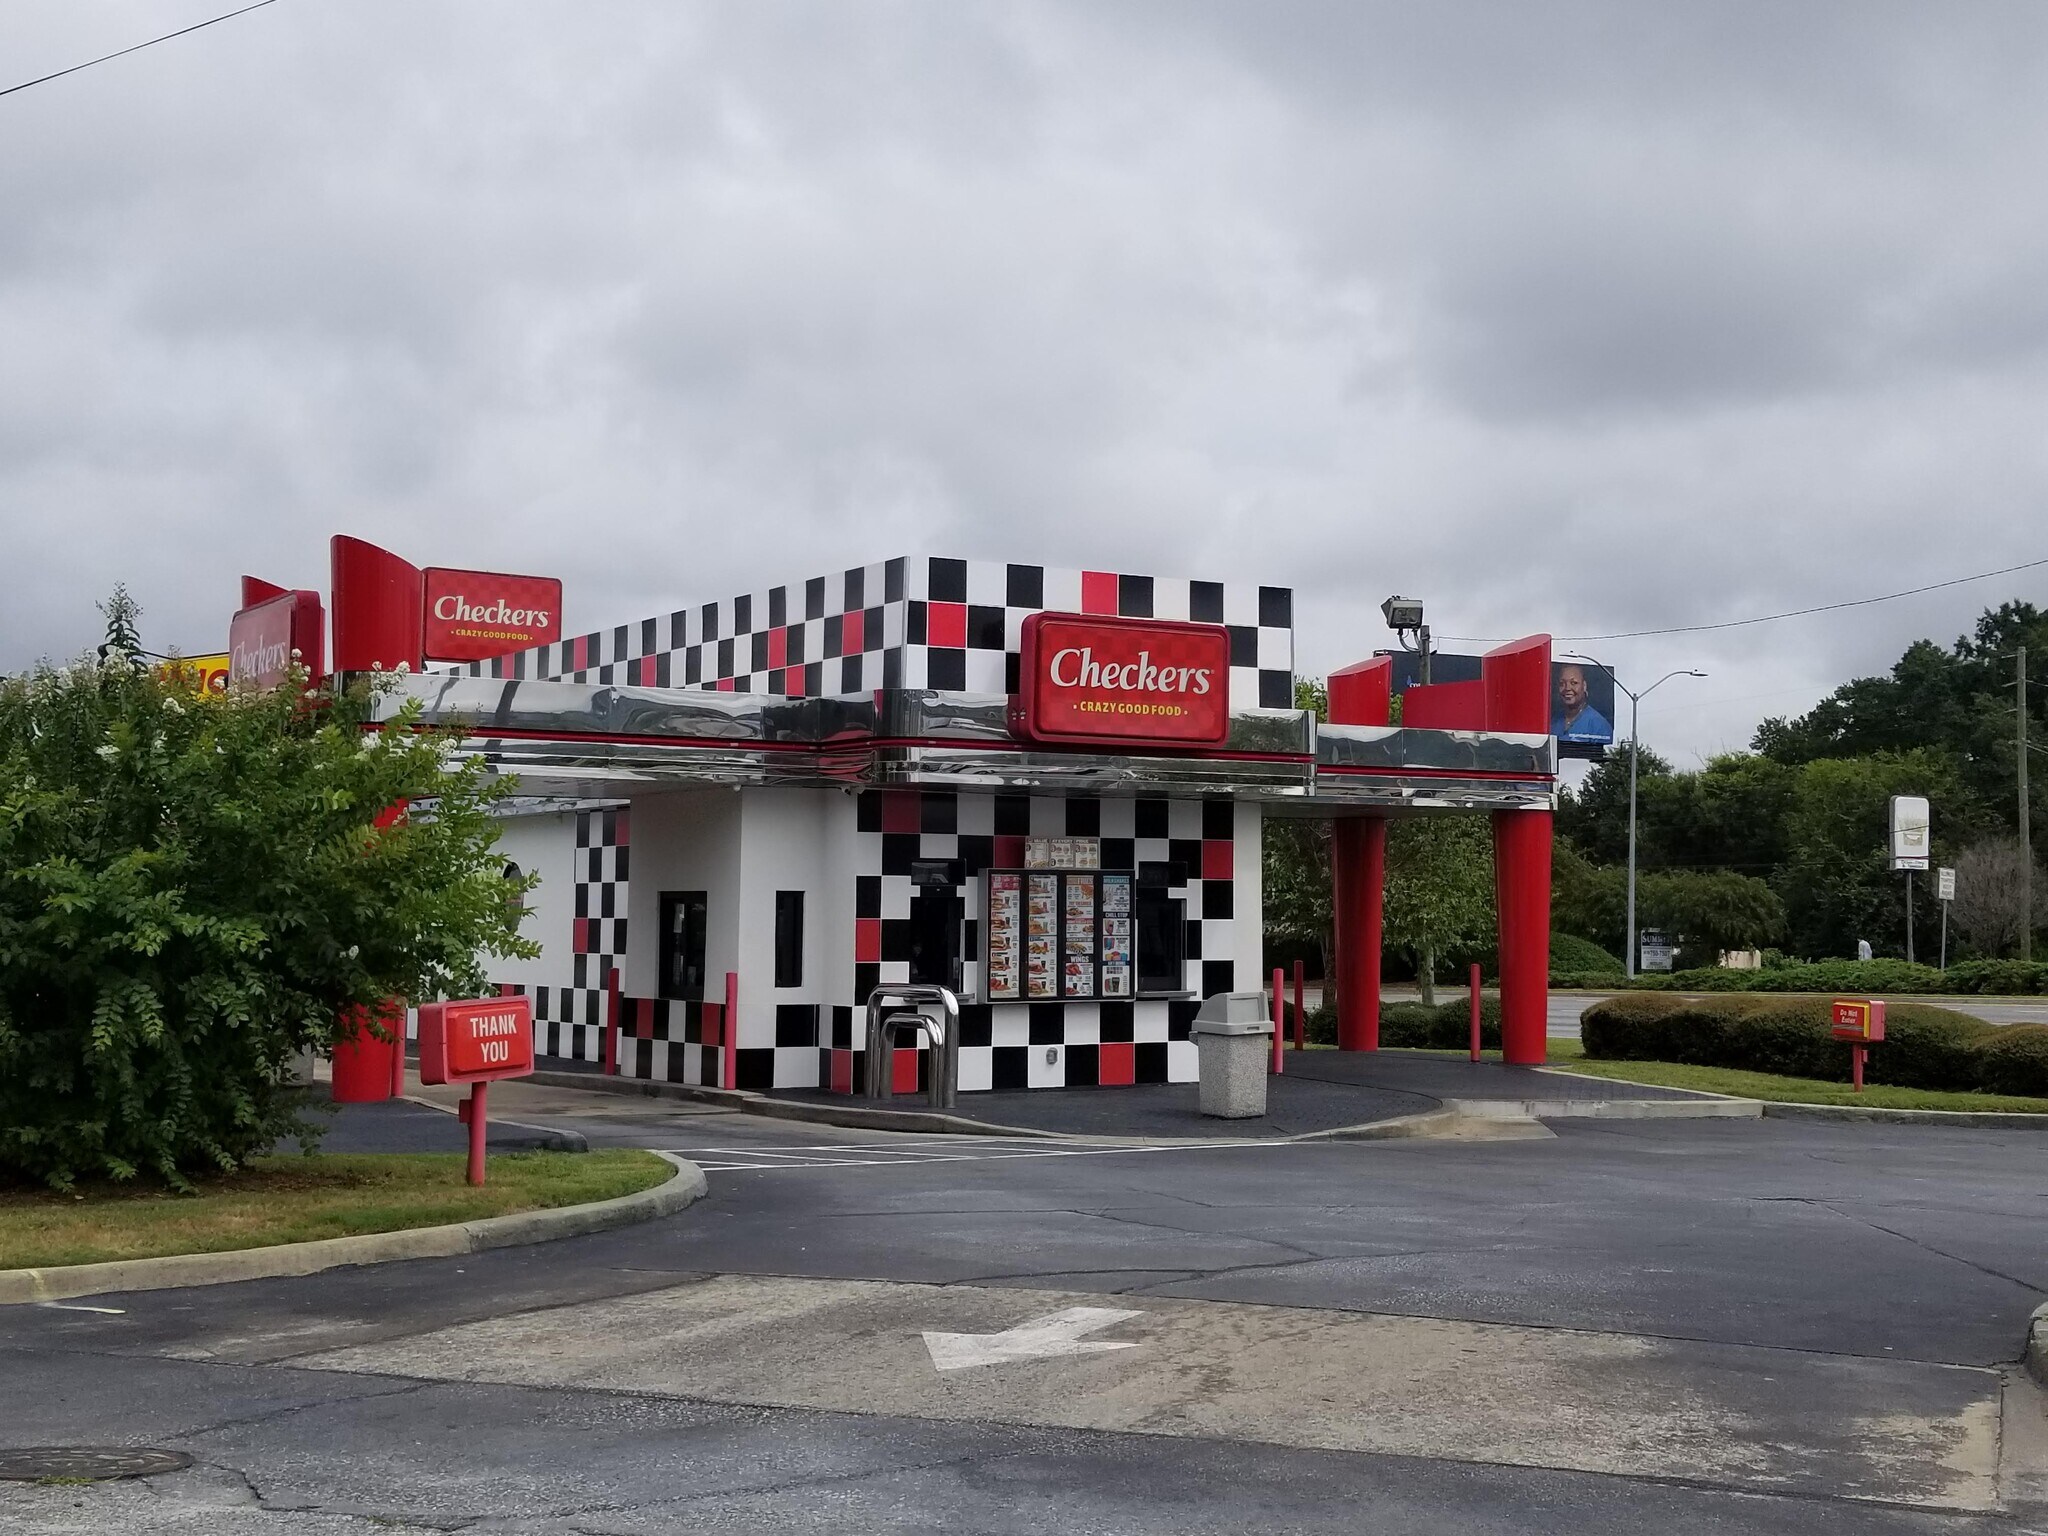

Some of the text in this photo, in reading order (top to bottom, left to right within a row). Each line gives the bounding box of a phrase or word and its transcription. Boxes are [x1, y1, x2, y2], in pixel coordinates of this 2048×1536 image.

[434, 595, 549, 628] Checkers
[455, 628, 529, 641] CRAZY GOOD FOOD
[231, 633, 286, 681] Checkers
[1050, 647, 1211, 695] Checkers
[1080, 700, 1182, 717] CRAZY GOOD FOOD
[1070, 955, 1090, 963] WINGS
[469, 1013, 517, 1038] THANK
[480, 1040, 509, 1064] YOU
